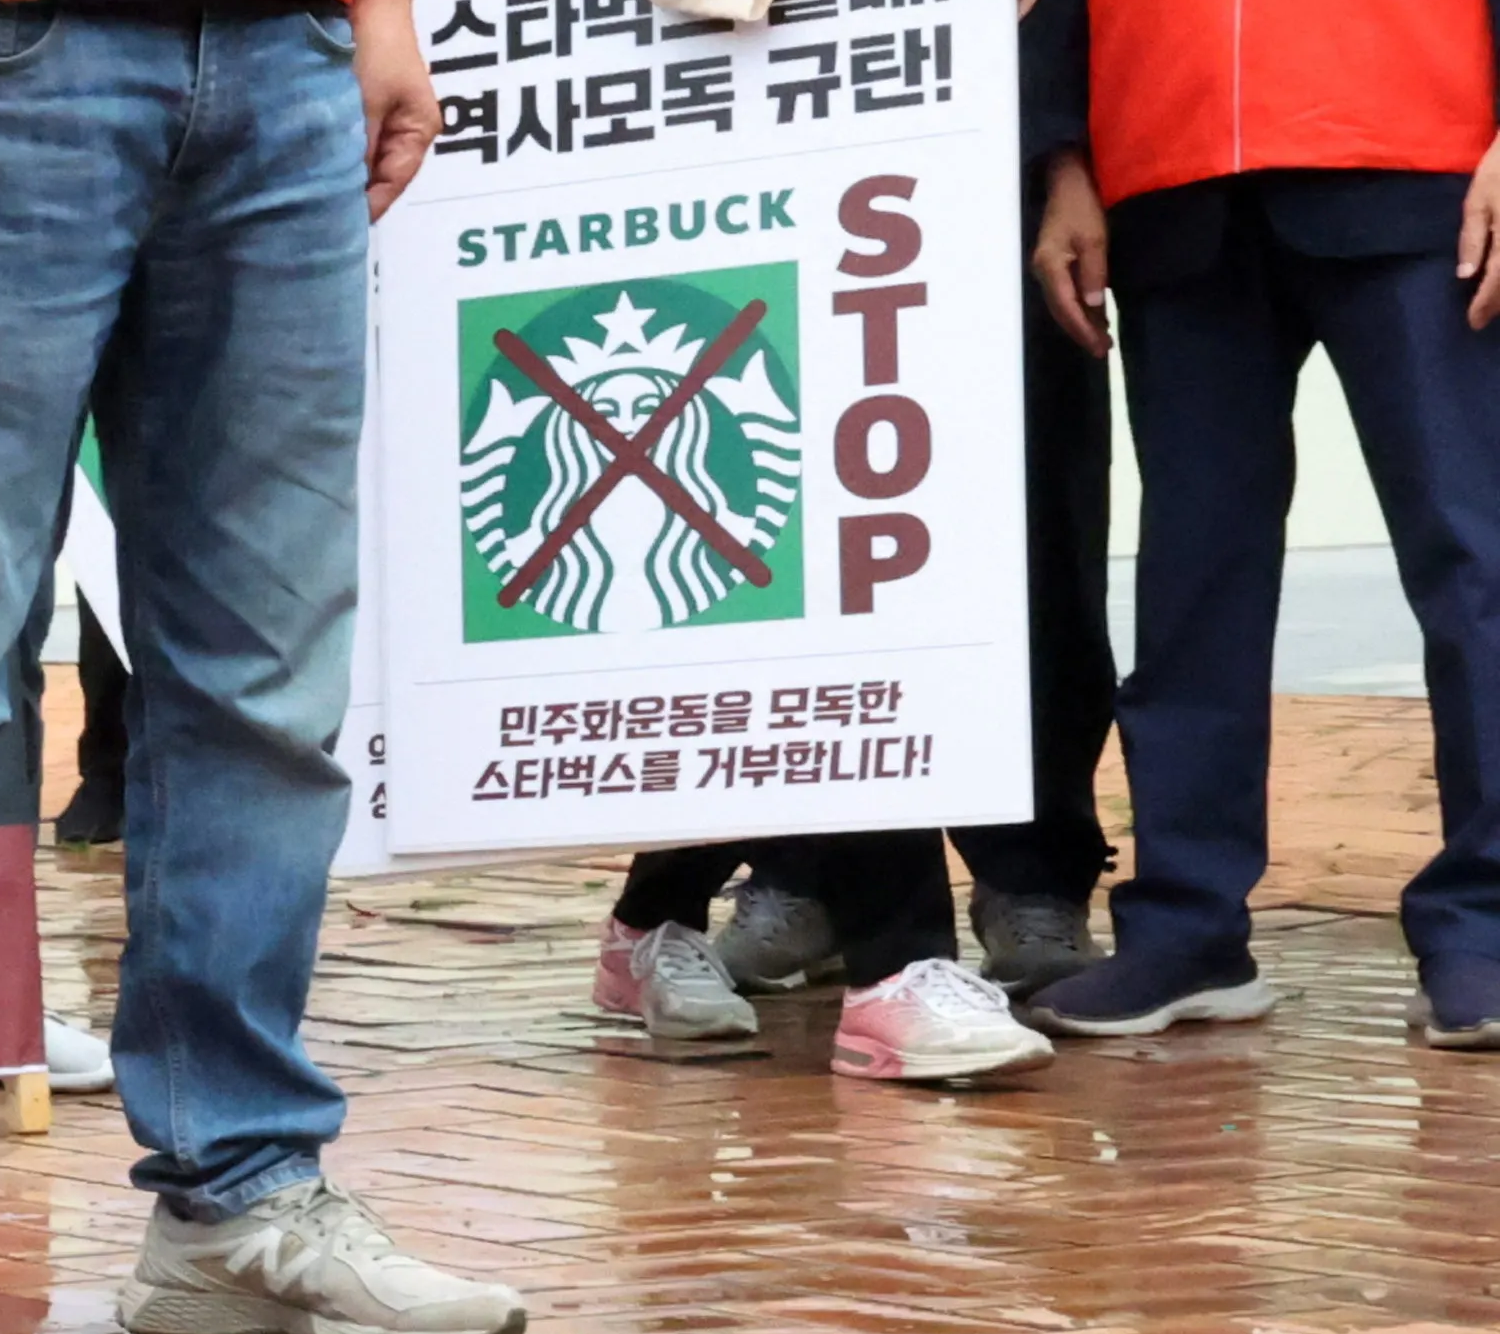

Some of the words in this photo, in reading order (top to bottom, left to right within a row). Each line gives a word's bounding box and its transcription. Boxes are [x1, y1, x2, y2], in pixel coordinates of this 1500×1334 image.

[433, 55, 735, 165] 역사모독
[766, 23, 952, 124] 규탄!
[456, 187, 797, 268] STARBUCK
[832, 174, 932, 616] STOP
[499, 689, 754, 748] 민주화운동을
[768, 679, 904, 730] 모독한
[471, 749, 681, 802] 스타벅스를
[696, 734, 933, 790] 거부합니다!
